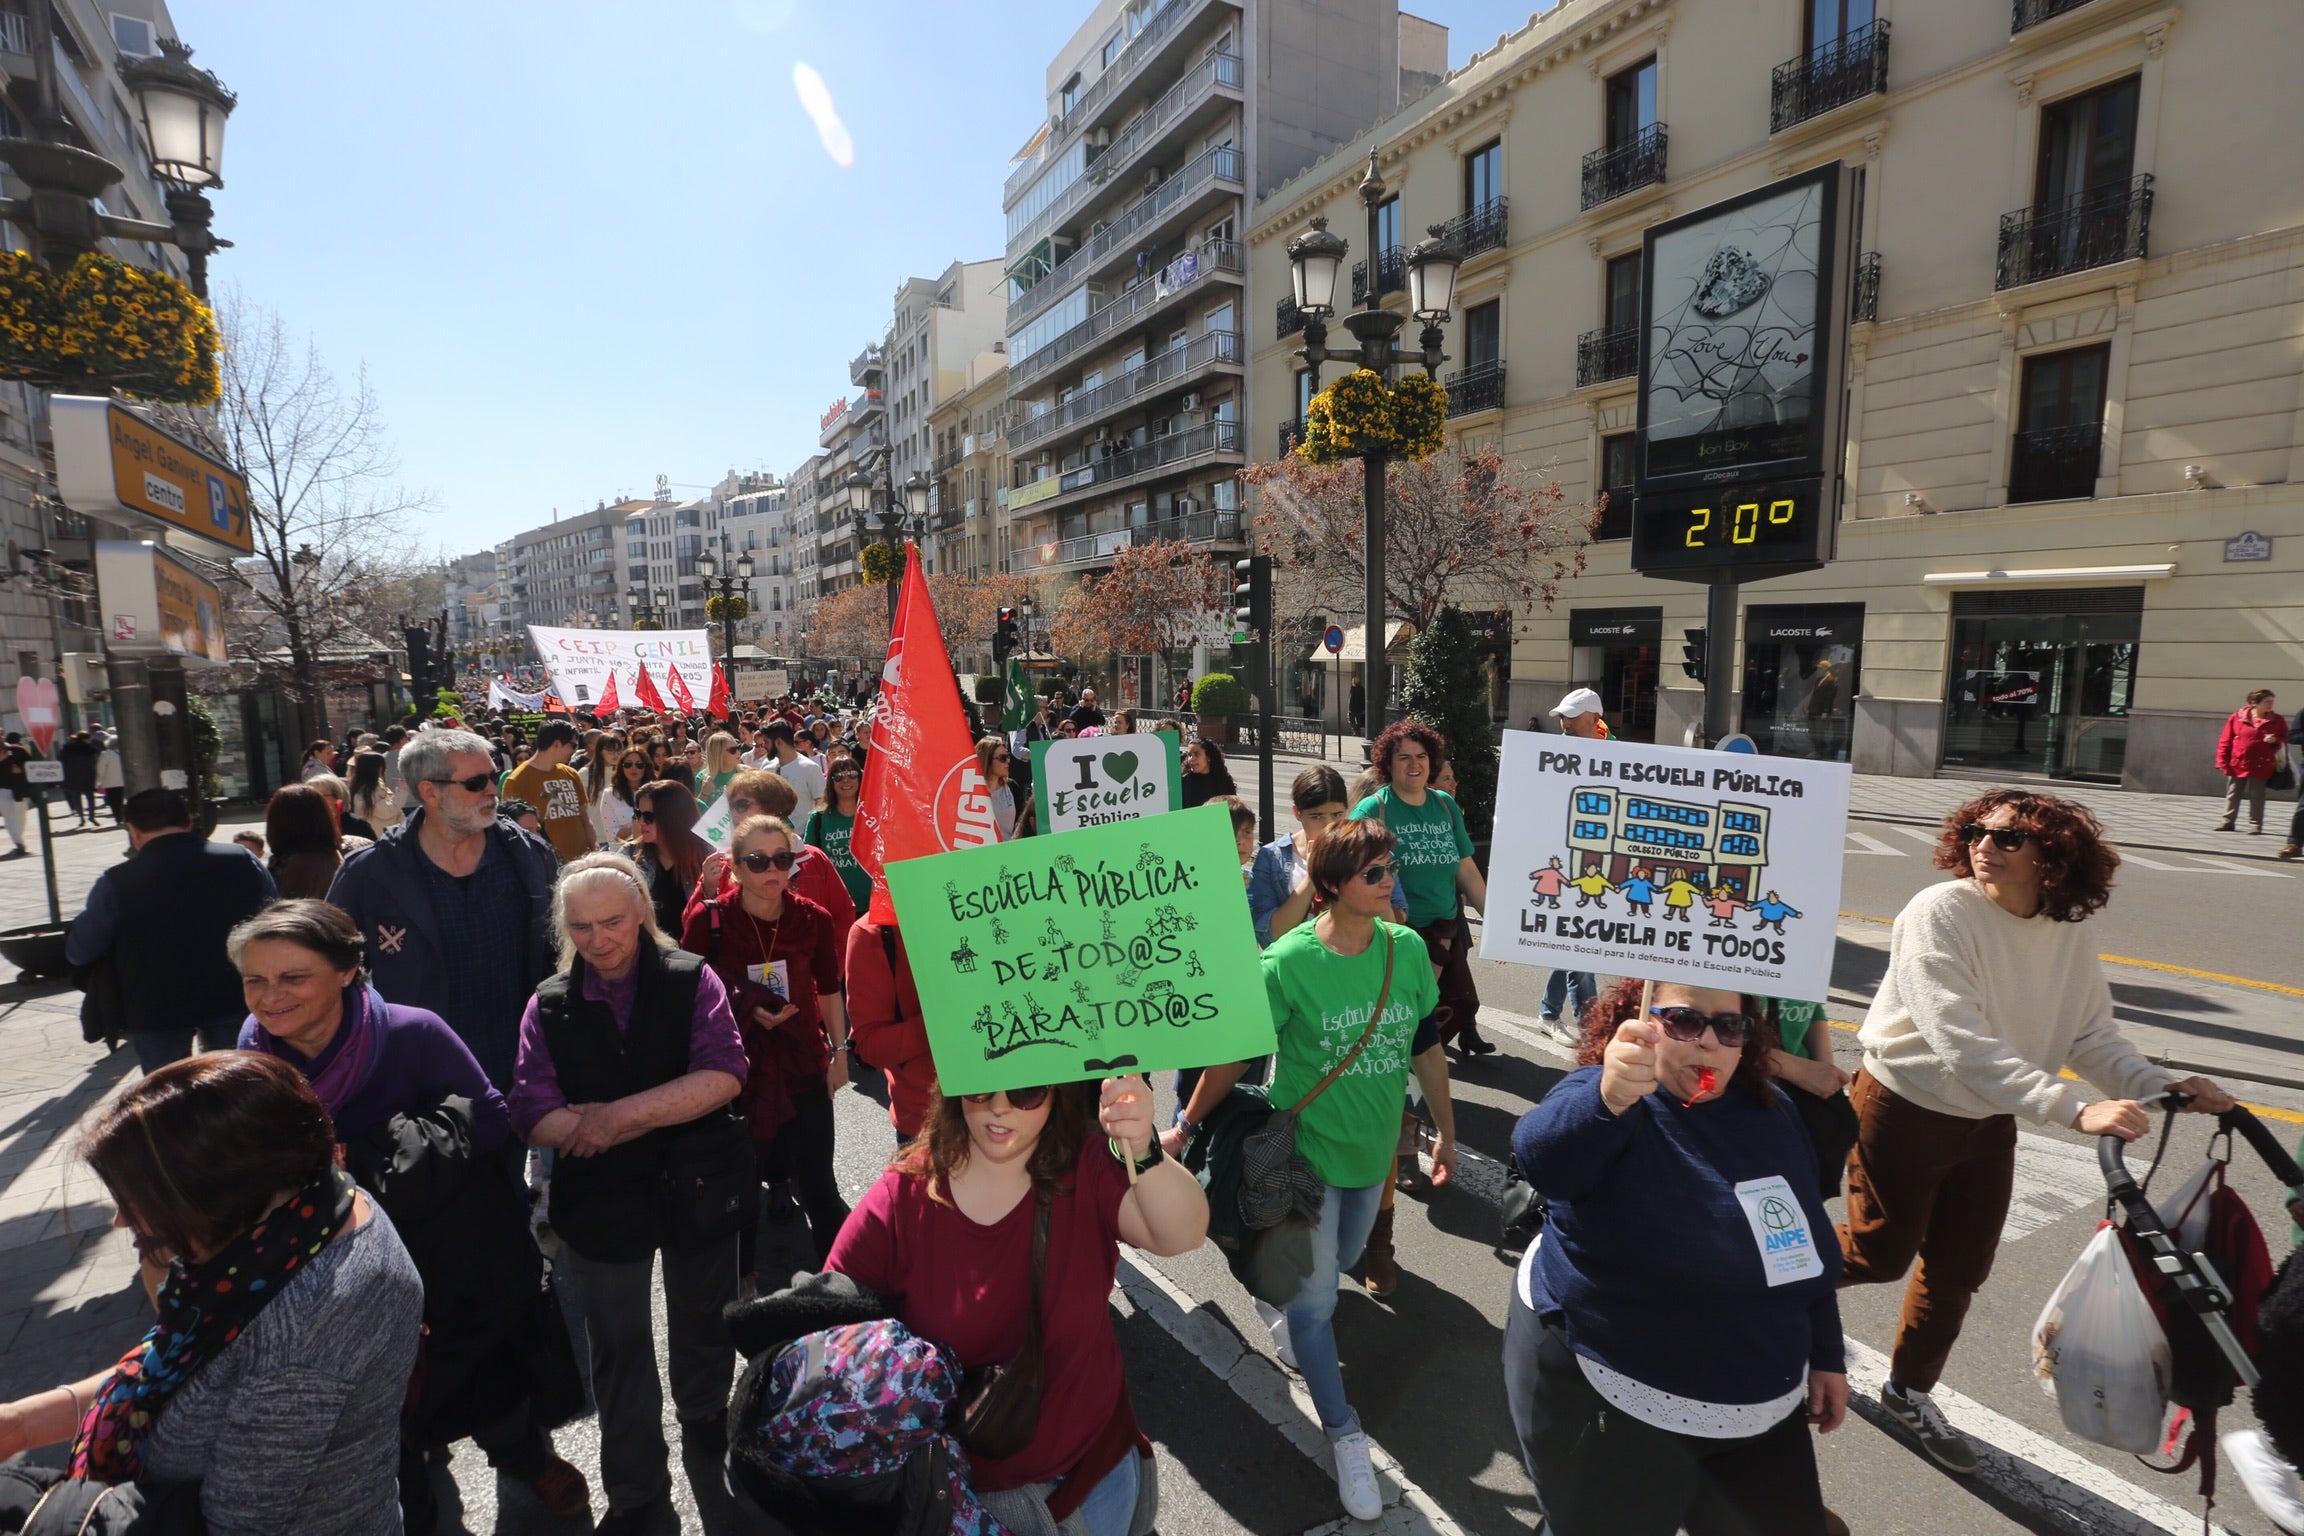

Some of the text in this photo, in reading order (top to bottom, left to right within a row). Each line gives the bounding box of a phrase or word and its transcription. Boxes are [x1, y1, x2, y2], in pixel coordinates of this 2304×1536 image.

[156, 445, 201, 486] Ganivet
[1703, 470, 1740, 481] JCDecaux
[146, 480, 185, 510] centro
[1770, 628, 1812, 636] LACOSTE
[543, 654, 560, 664] LA
[567, 655, 604, 666] JUNTA
[558, 638, 700, 658] CEIP GENIL
[565, 666, 602, 675] INFANTIL
[1072, 754, 1099, 790] I
[1538, 751, 1803, 798] POR LA ESCUELA PÚBLICA
[543, 779, 575, 793] OPEN
[558, 791, 579, 804] THE
[1053, 776, 1156, 816] Escuela
[550, 804, 580, 819] GAME
[1078, 811, 1140, 828] Pública
[1627, 844, 1700, 860] COLEGIO PÚBLICO
[950, 861, 1199, 921] ESCUELA PÚBLICA:
[1520, 909, 1786, 965] LA ESCUELA DE TODOS
[992, 935, 1182, 985] DE TOD@S
[1519, 937, 1782, 979] Movimiento Social para la defensa de la Escuela Pública
[986, 993, 1219, 1047] PARA TOD@S
[1765, 1228, 1808, 1252] ANPE
